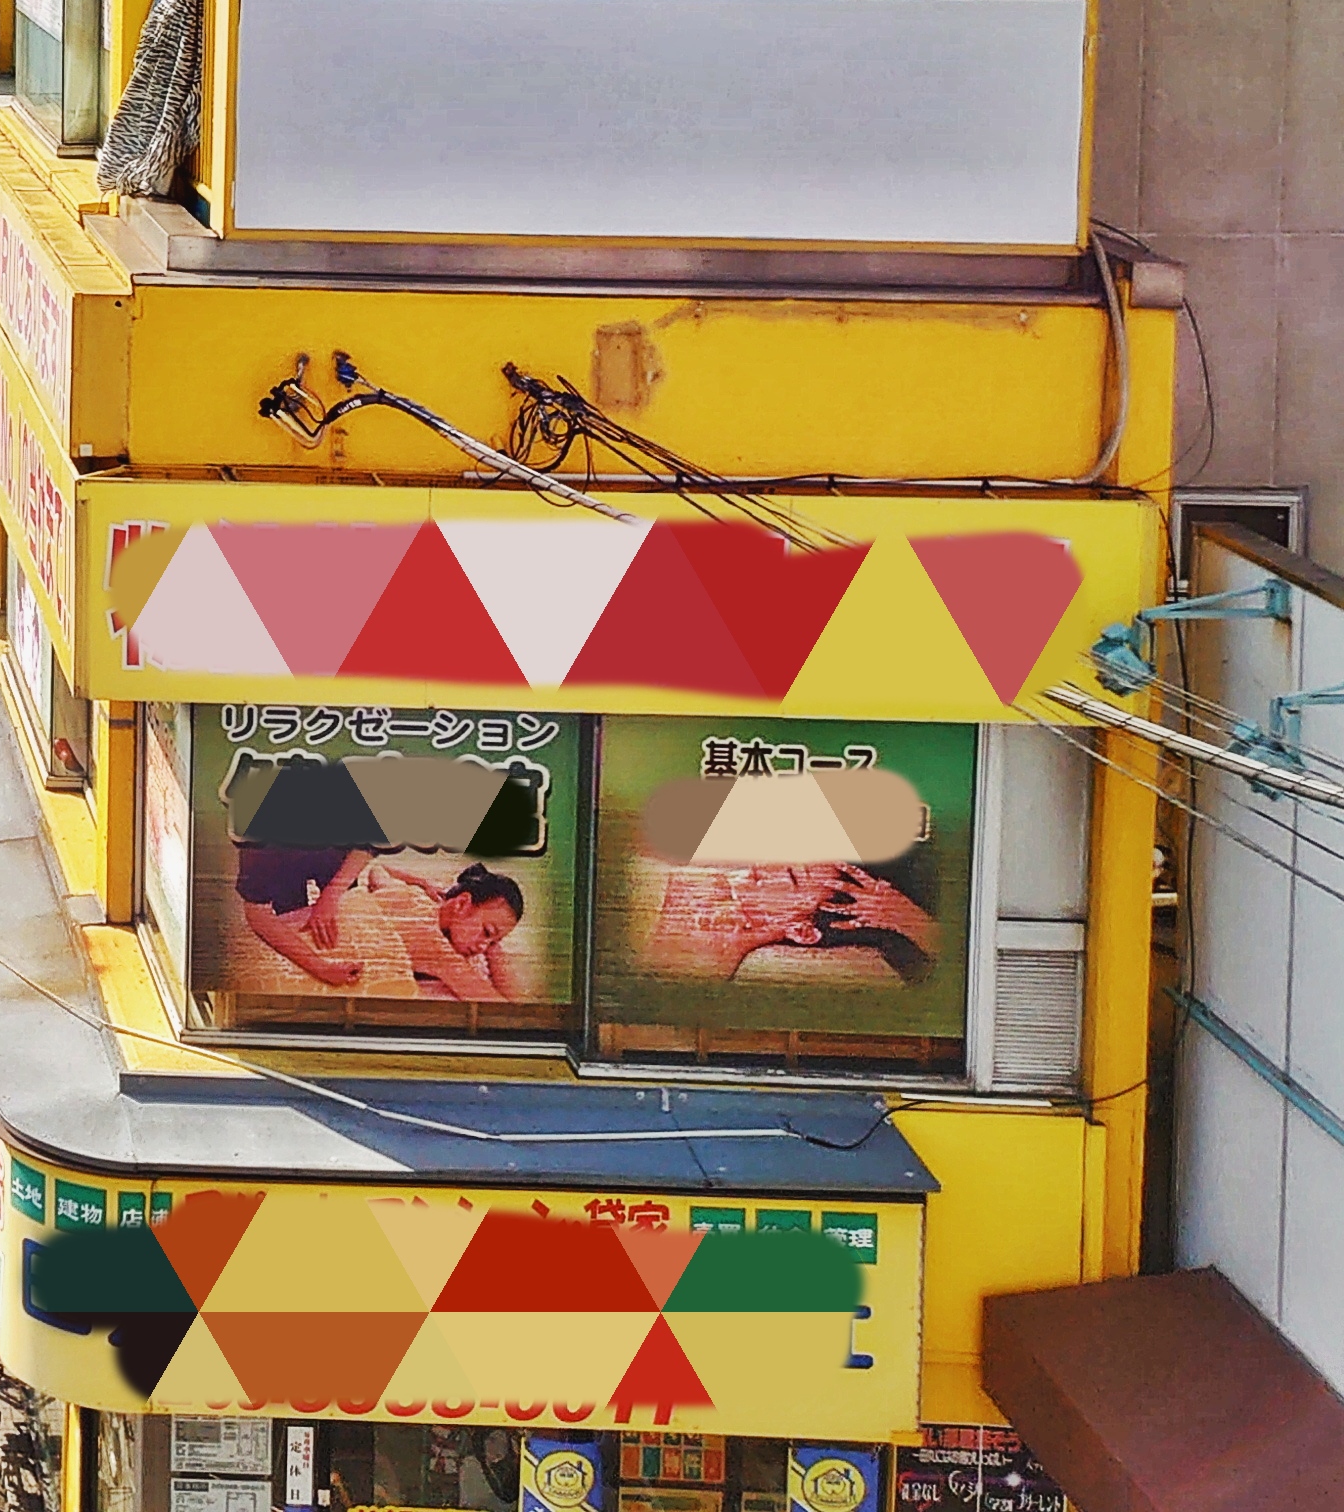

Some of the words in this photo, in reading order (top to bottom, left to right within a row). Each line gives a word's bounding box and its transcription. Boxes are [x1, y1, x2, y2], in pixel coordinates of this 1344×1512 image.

[221, 705, 559, 750] リラクゼーション
[11, 1177, 43, 1209] 土地
[57, 1198, 103, 1225] 建物
